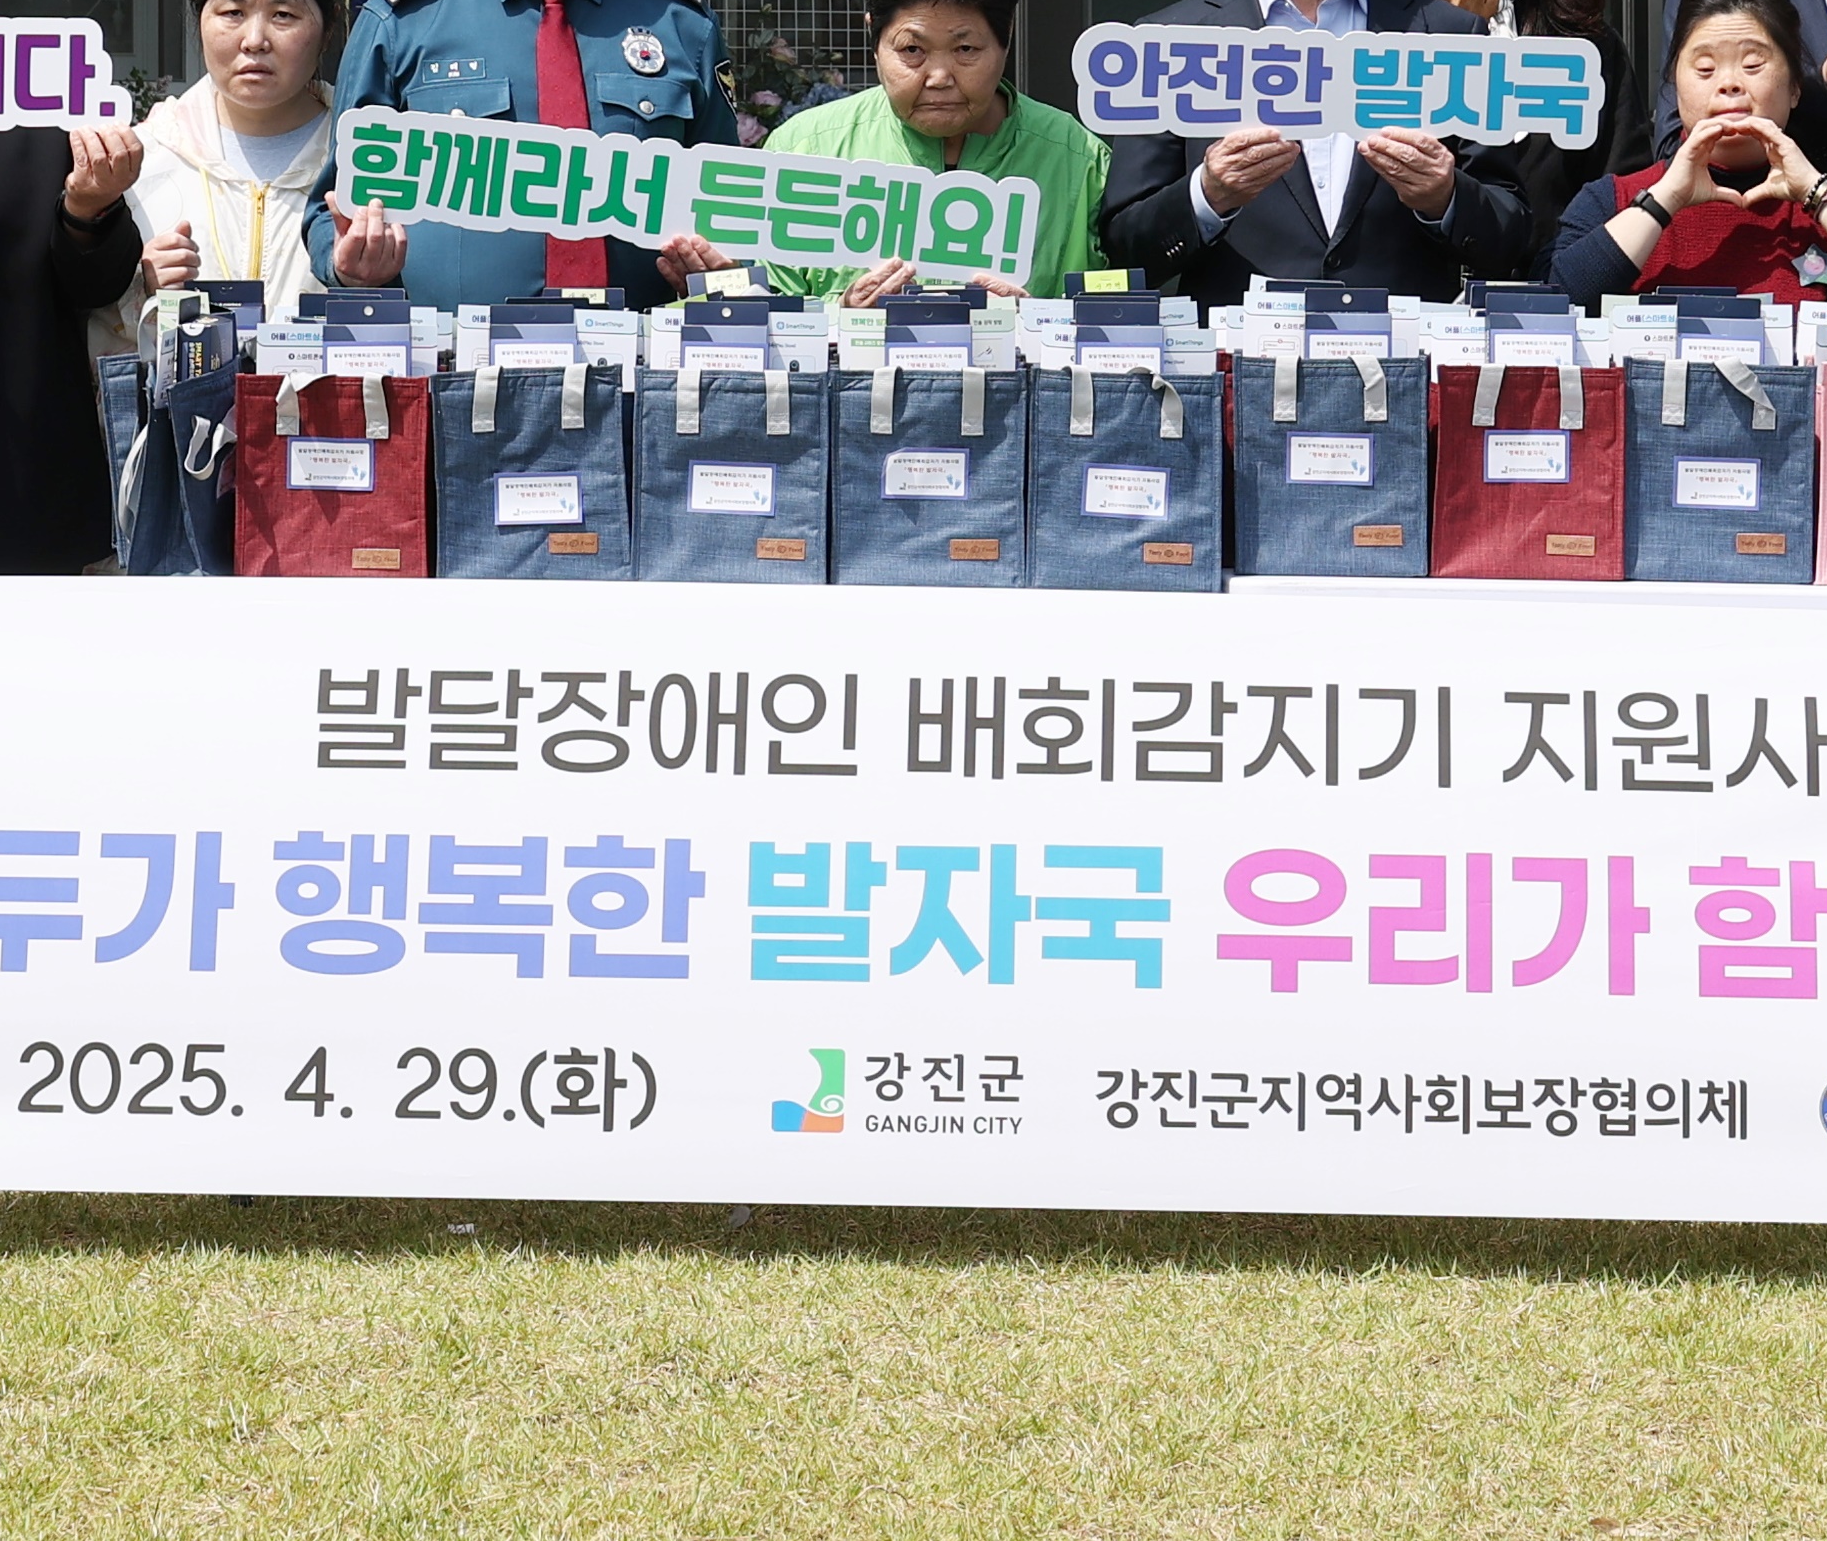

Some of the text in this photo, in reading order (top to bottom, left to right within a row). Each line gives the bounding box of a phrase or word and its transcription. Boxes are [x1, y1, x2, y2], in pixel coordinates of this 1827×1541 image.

[1088, 39, 1590, 135] 안전한 발자국
[350, 122, 1026, 274] 함께라서 든든해요!
[594, 319, 624, 328] SmartThings
[785, 322, 816, 330] SmartThings
[1175, 339, 1204, 347] SmartThings
[315, 667, 859, 777] 발달장애인
[908, 676, 1452, 789] 배회감지기
[272, 830, 706, 979] 행복한
[747, 840, 1171, 990] 발자국
[1216, 847, 1651, 997] 우리가
[17, 1041, 658, 1134] 2025. 4. 29.(화)
[864, 1052, 1025, 1104] 강진군
[1095, 1069, 1750, 1140] 강진군지역사회보장협의체
[865, 1114, 1023, 1136] GANGJIN CITY
